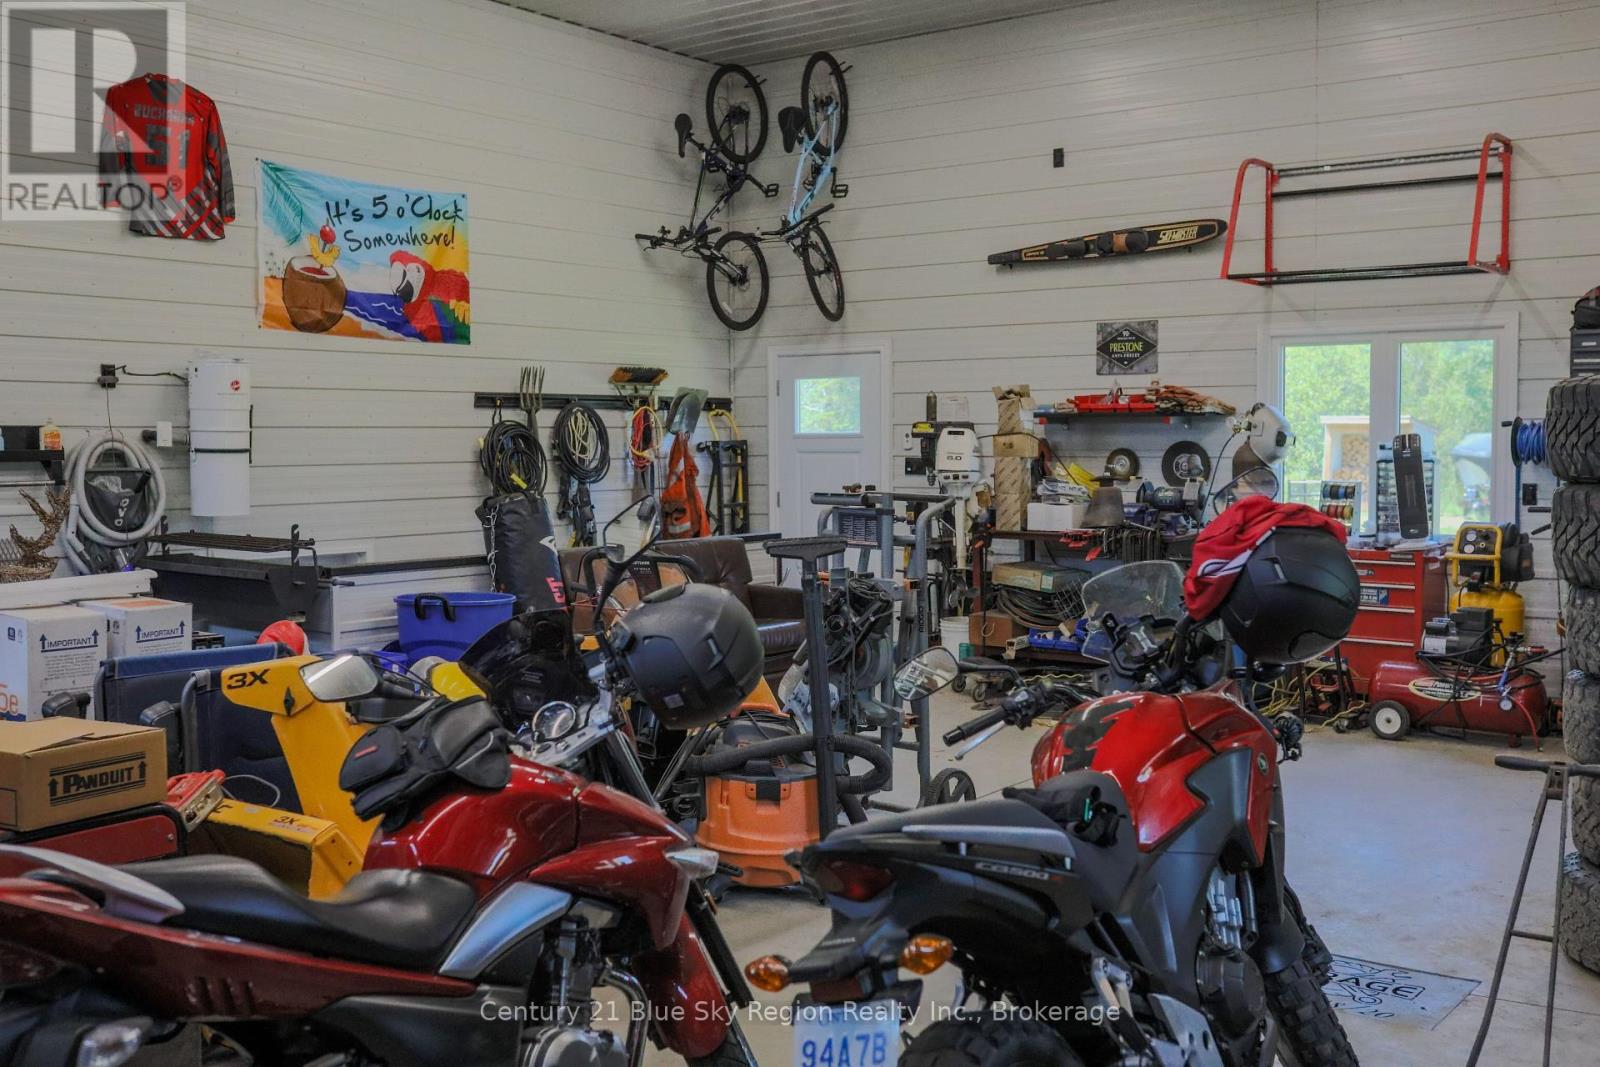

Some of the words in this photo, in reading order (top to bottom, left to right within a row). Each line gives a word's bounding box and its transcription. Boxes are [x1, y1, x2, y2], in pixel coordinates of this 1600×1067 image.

[145, 125, 191, 169] 51
[325, 198, 364, 227] It's
[372, 194, 389, 219] 5
[343, 225, 456, 252] Somewhere!
[1109, 341, 1143, 352] PRESTONE
[47, 637, 93, 648] IMPORTANT
[141, 628, 180, 639] IMPORTANT
[226, 668, 272, 690] 3X
[62, 766, 135, 794] PANDUIT
[802, 1032, 887, 1067] 94A7B
